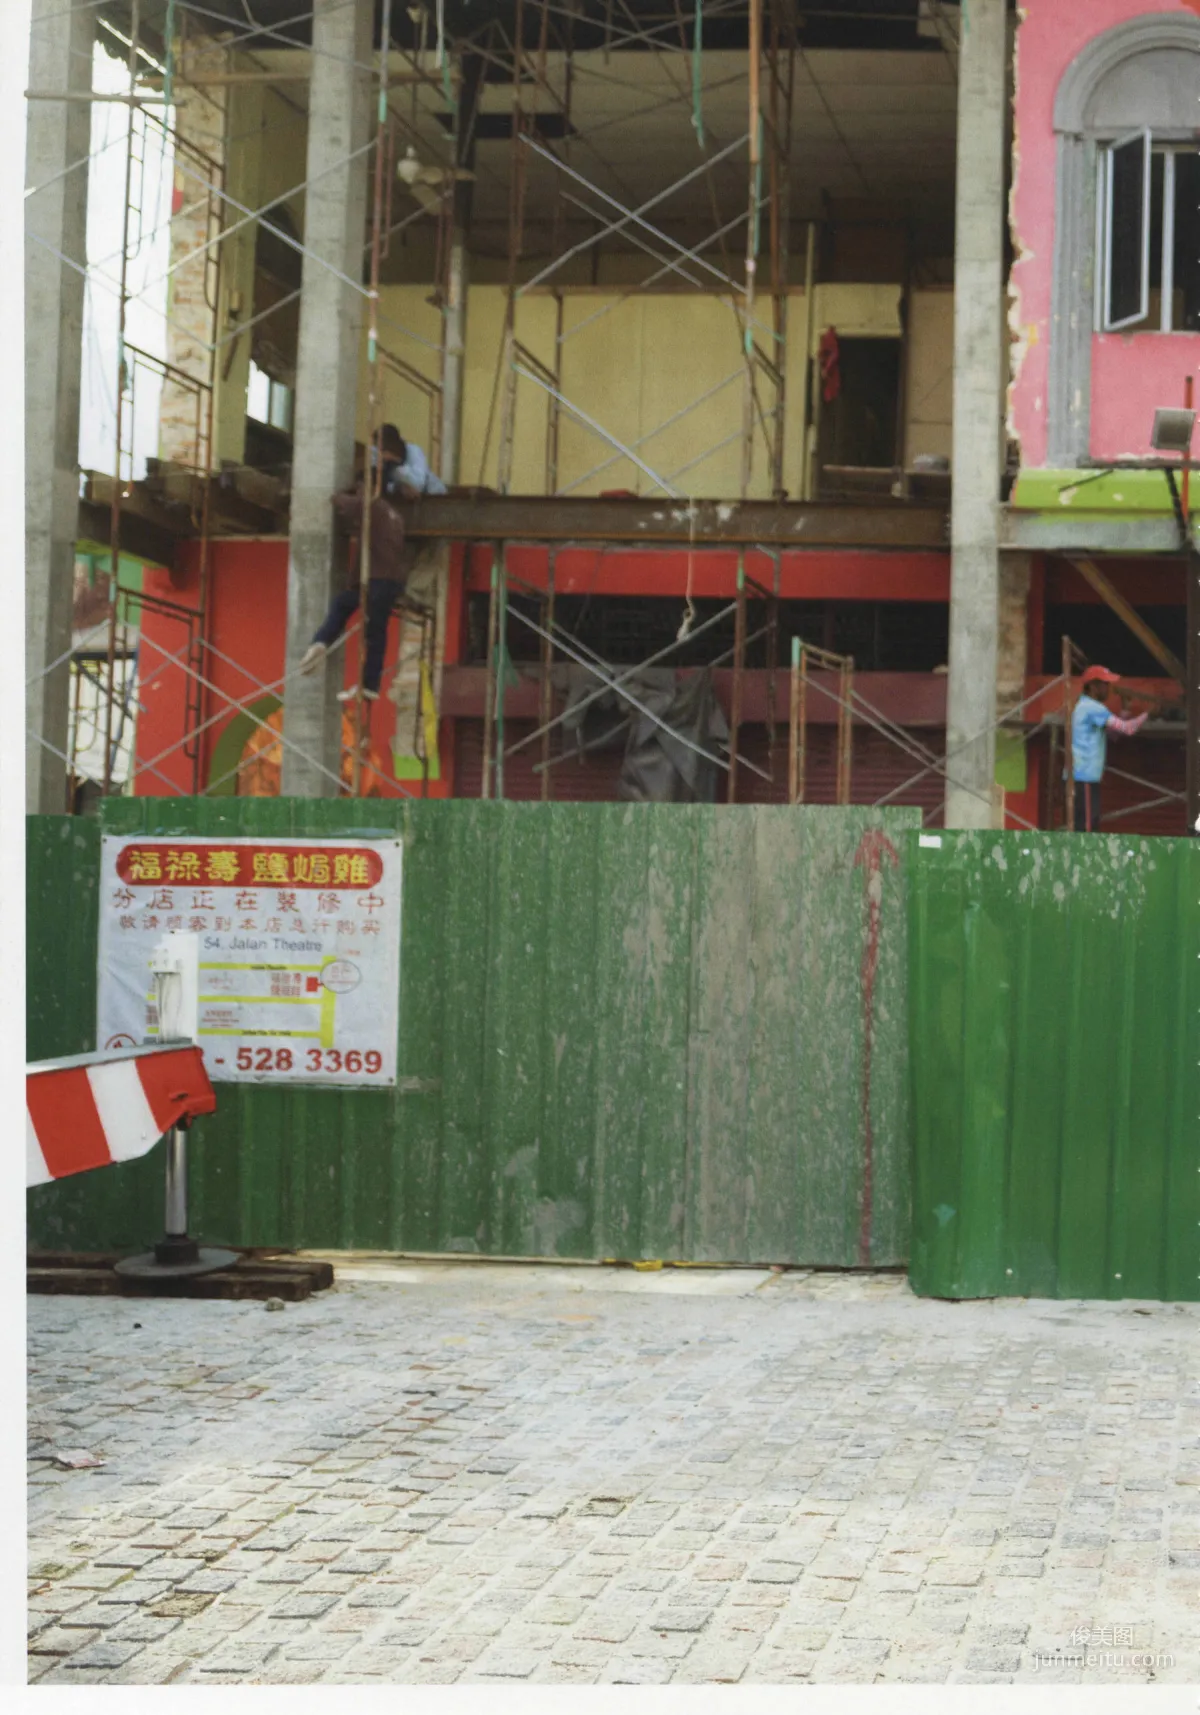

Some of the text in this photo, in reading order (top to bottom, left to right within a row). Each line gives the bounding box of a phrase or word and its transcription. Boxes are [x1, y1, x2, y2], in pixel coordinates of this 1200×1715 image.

[228, 935, 267, 950] Jalan
[270, 937, 324, 953] Theatre
[236, 1047, 293, 1071] 528
[305, 1049, 382, 1074] 3369
